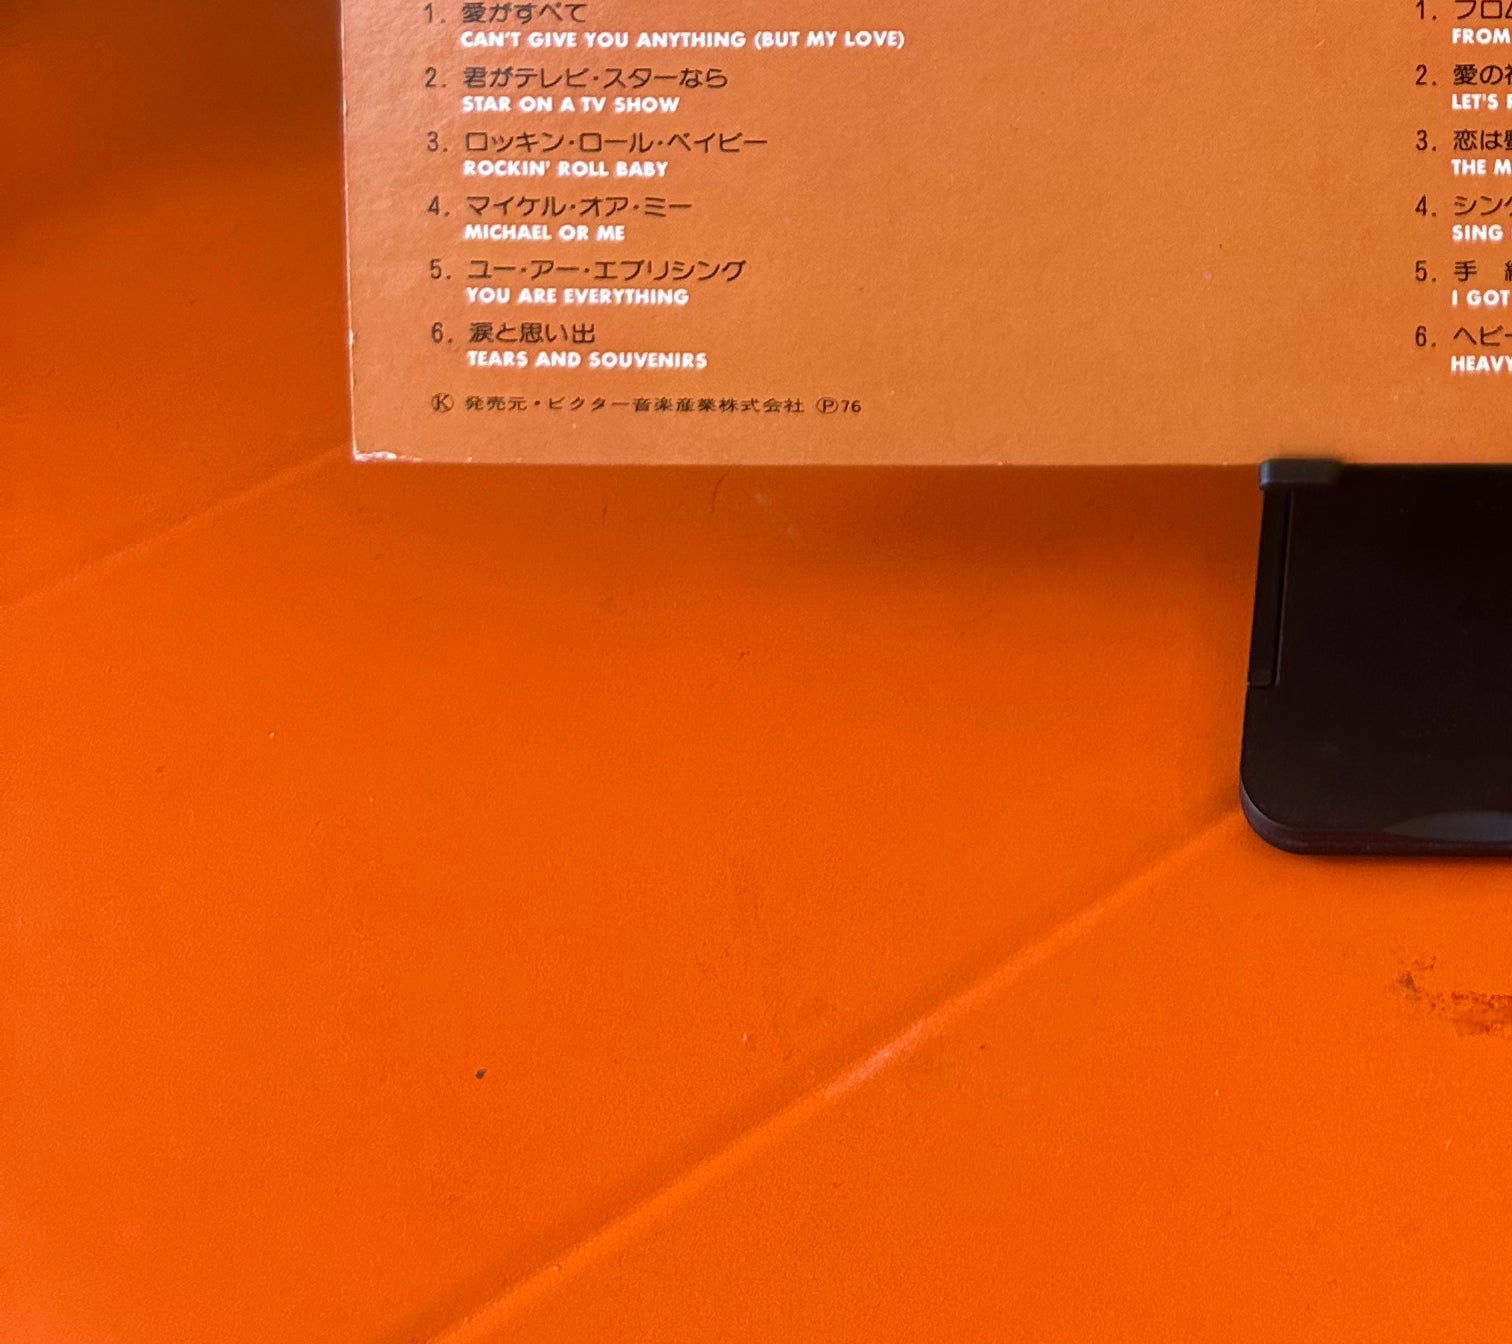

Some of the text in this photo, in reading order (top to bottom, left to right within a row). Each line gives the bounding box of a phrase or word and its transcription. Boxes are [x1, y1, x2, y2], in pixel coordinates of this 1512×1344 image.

[424, 2, 587, 24] 1. 愛がすべて
[1416, 0, 1436, 20] 1.
[460, 31, 904, 50] CAN'T GIVE YOU ANYTHING (BUT MY LOVE)
[1453, 28, 1510, 44] FROM
[425, 67, 446, 88] 2.
[1416, 65, 1436, 86] 2.
[463, 96, 679, 113] STAR ON A TV SHOW
[1452, 94, 1498, 110] LET'S
[427, 131, 448, 152] 3.
[1416, 130, 1436, 151] 3.
[464, 160, 667, 177] ROCKIN' ROLL BABY
[1452, 159, 1486, 175] THE
[428, 196, 449, 216] 4.
[1415, 195, 1436, 216] 4.
[463, 225, 624, 241] MICHAEL OR ME
[1453, 225, 1503, 241] SING
[430, 259, 451, 279] 5.
[1416, 260, 1436, 282] 5.
[466, 288, 688, 305] YOU ARE EVERYTHING
[1452, 290, 1457, 306] I
[1467, 290, 1510, 306] GOT
[432, 322, 595, 344] 6. 涙と思い出
[1416, 326, 1436, 347] 6.
[468, 351, 707, 369] TEARS AND SOUVENIRS
